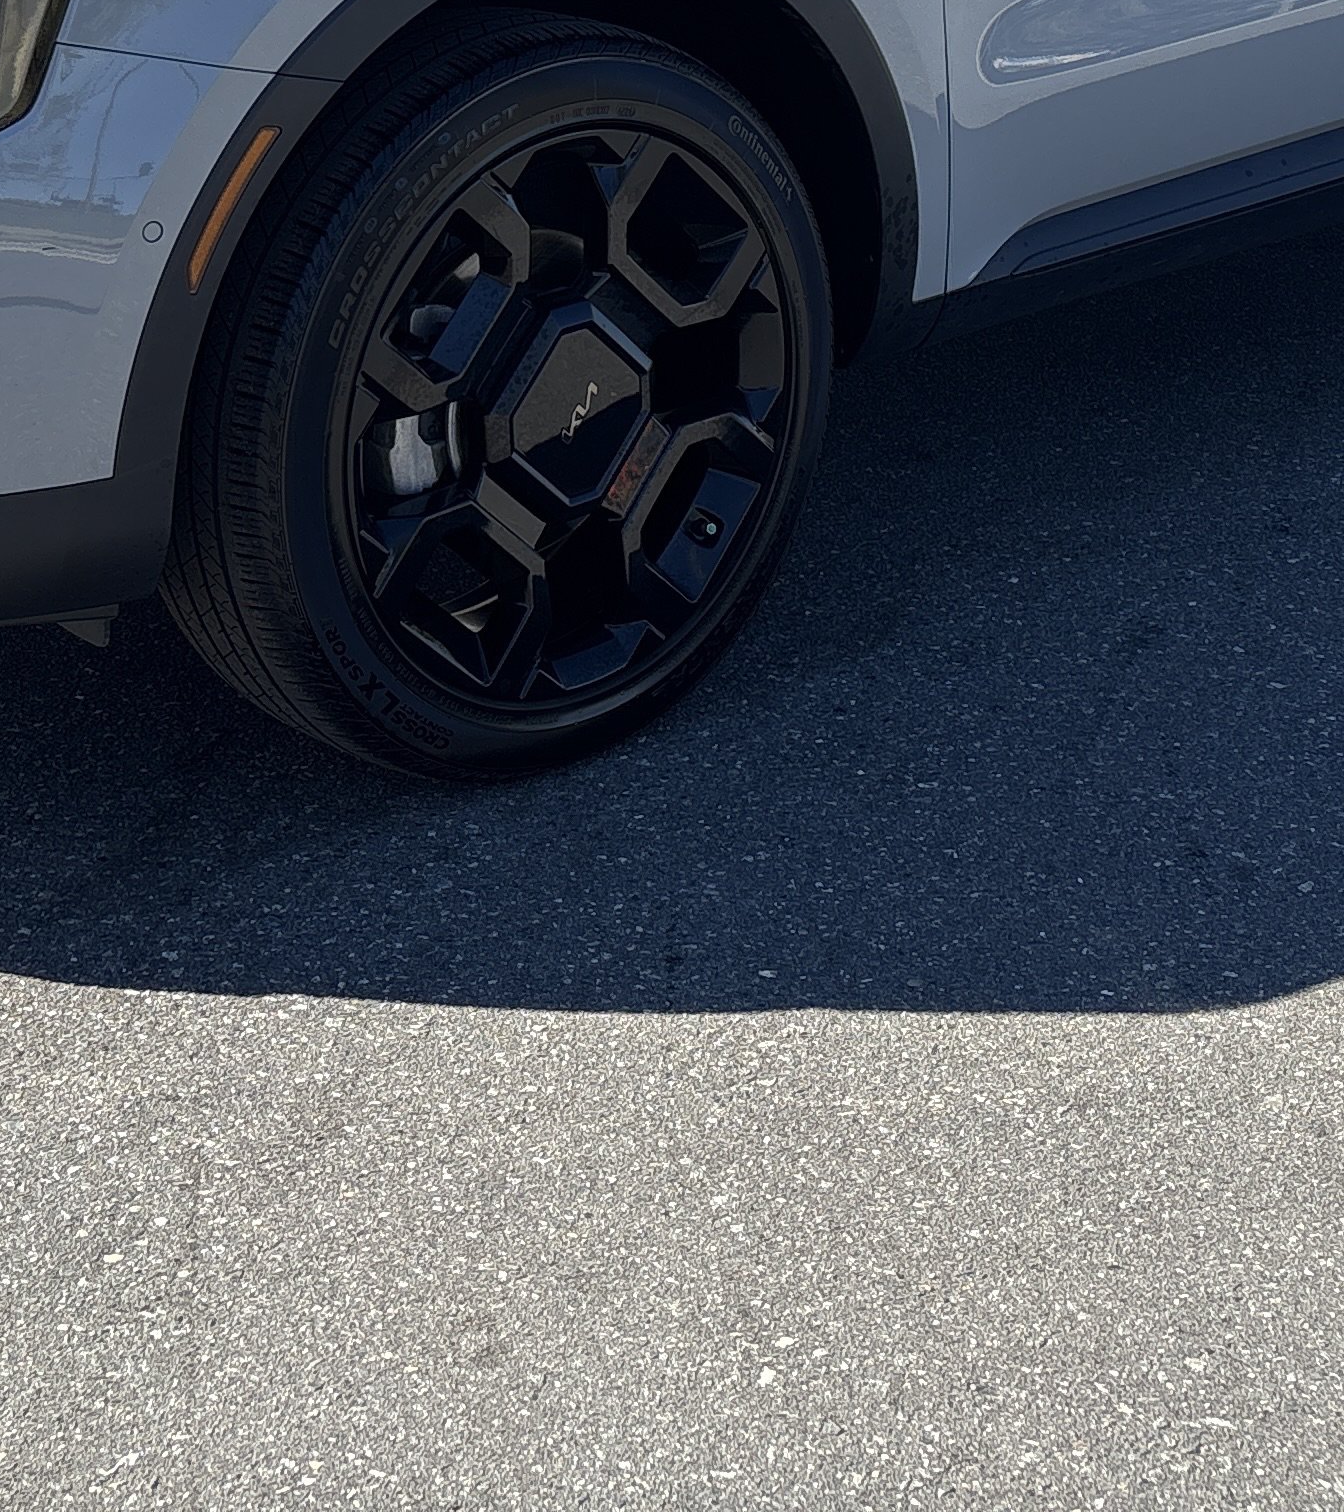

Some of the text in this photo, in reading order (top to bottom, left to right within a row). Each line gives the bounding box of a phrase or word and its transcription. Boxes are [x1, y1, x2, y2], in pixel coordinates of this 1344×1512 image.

[727, 114, 788, 191] Continental
[356, 671, 400, 716] LX
[390, 710, 450, 750] CROSS
